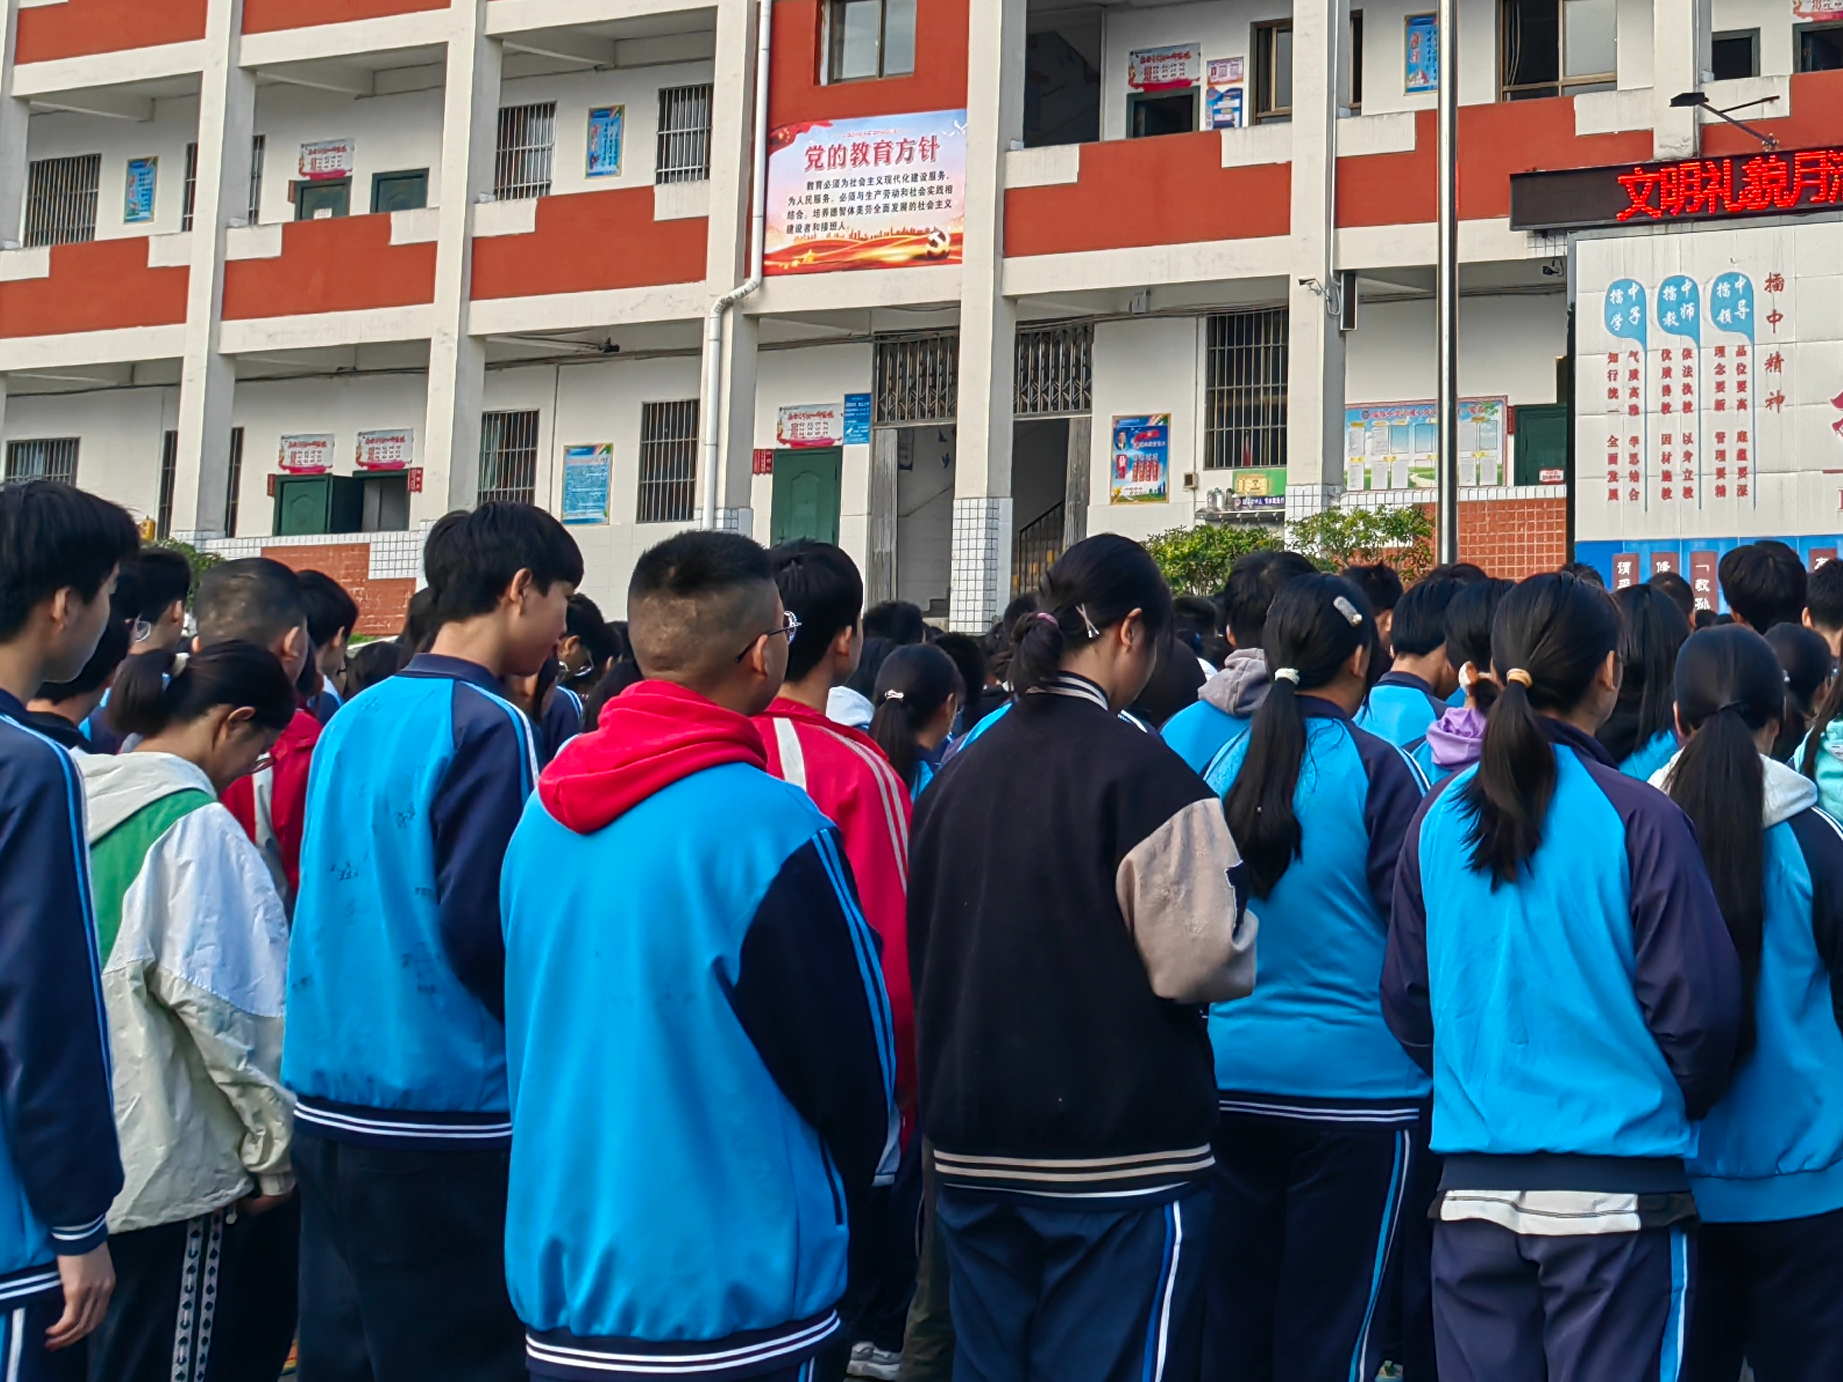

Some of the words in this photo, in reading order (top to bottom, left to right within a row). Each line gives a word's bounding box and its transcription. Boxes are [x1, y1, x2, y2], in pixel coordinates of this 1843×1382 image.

[805, 135, 941, 173] 党的教育方针
[1764, 272, 1786, 414] 擂中精神
